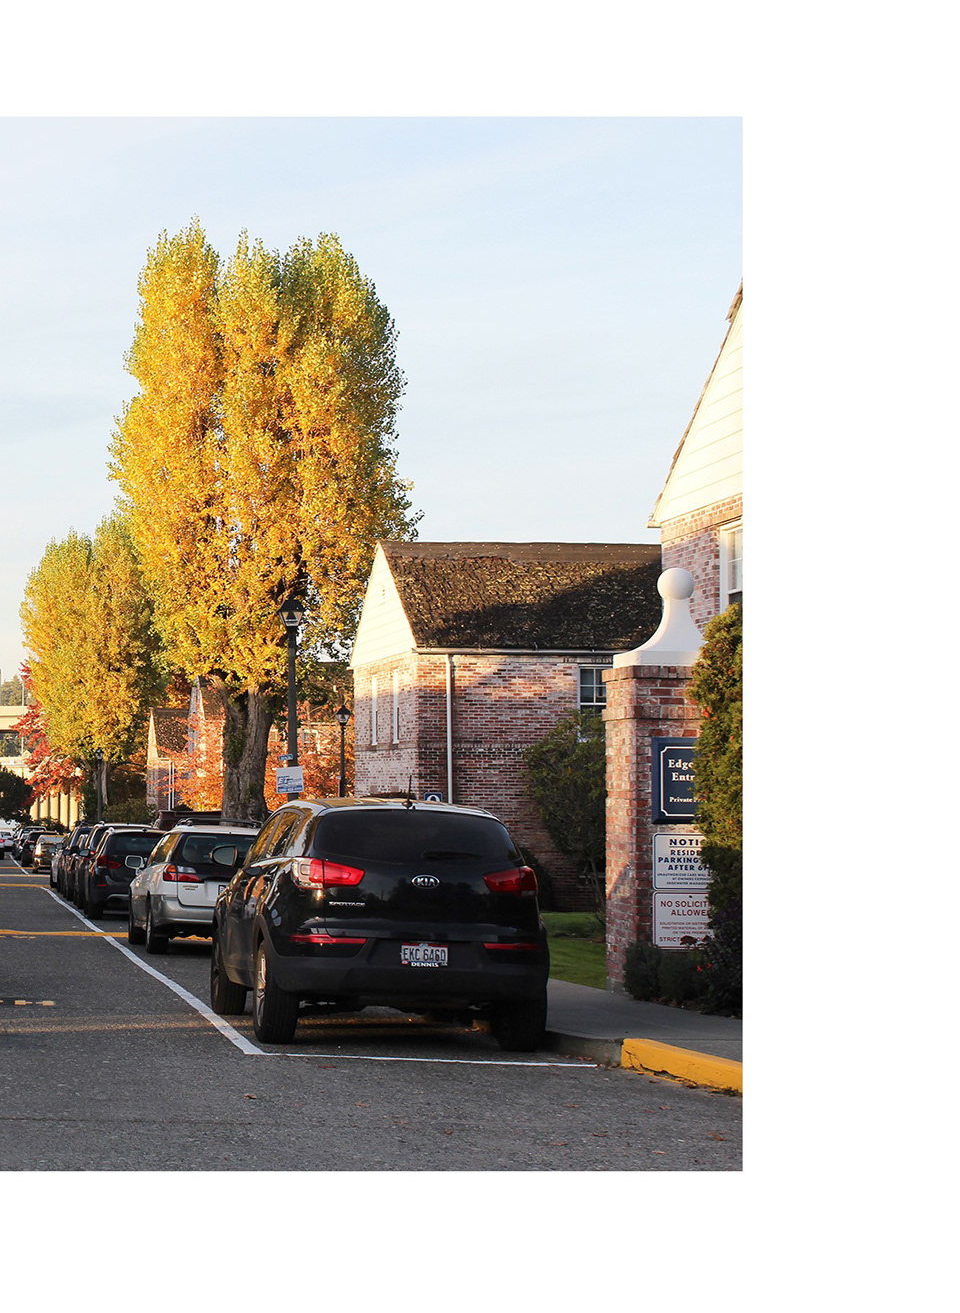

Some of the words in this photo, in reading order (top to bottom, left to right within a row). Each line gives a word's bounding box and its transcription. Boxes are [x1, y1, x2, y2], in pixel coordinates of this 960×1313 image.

[672, 772, 695, 781] Entr
[669, 838, 699, 846] NOTI
[417, 878, 436, 886] KIA
